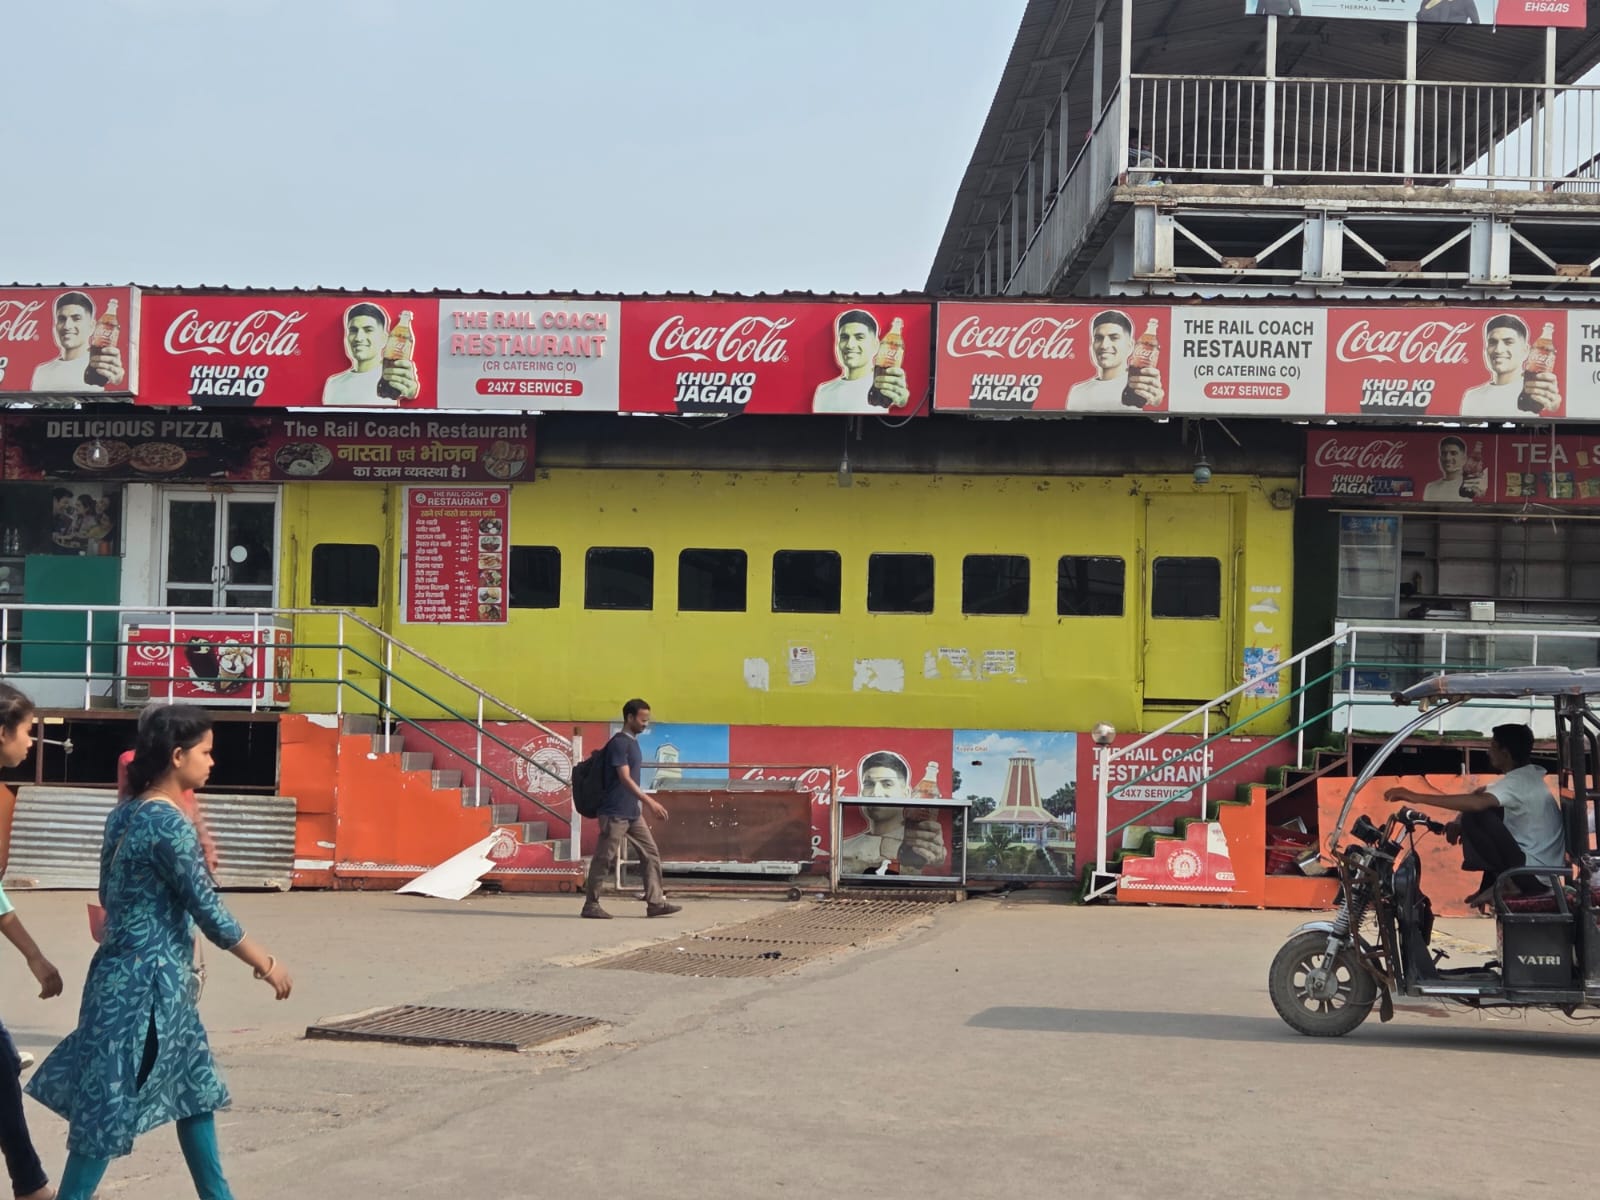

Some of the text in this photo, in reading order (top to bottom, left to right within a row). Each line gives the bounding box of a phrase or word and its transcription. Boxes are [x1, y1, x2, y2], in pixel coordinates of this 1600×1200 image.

[1525, 2, 1570, 13] EHSAAS
[453, 311, 608, 330] THE RAIL COACH
[1184, 320, 1314, 335] THE RAIL COACH
[164, 309, 308, 356] Coca-Cola
[650, 315, 796, 362] Coca-Cola
[946, 314, 1083, 360] Coca-Cola
[451, 334, 607, 358] RESTAURANT
[1183, 340, 1312, 358] RESTAURANT
[1336, 320, 1476, 364] Coca-Cola
[190, 365, 269, 379] KHUD KO
[482, 361, 577, 373] (CR CATERING CO)
[1194, 365, 1301, 379] (CR CATERING CO)
[675, 372, 756, 386] KHUD KO
[971, 374, 1043, 387] KHUD KO
[1362, 378, 1435, 391] KHUD KO
[188, 378, 265, 397] JAGAO
[487, 382, 573, 394] 24X7 SERVICE
[674, 385, 752, 404] JAGAO
[969, 385, 1039, 403] JAGAO
[1212, 386, 1282, 396] 24X7 SERVICE
[1360, 391, 1431, 407] JAGAO
[47, 421, 223, 438] DELICIOUS PIZZA
[284, 421, 527, 438] The Rail Coach Restaurant
[421, 441, 479, 462] भोजन
[1315, 438, 1408, 469] Coca-Cola
[1511, 443, 1568, 464] TEA
[353, 467, 371, 477] का
[1332, 474, 1364, 483] KHUD
[428, 498, 488, 506] RESTAURANT
[1125, 748, 1158, 761] RAIL
[1162, 748, 1214, 762] COACH
[1517, 955, 1561, 966] YATRI
